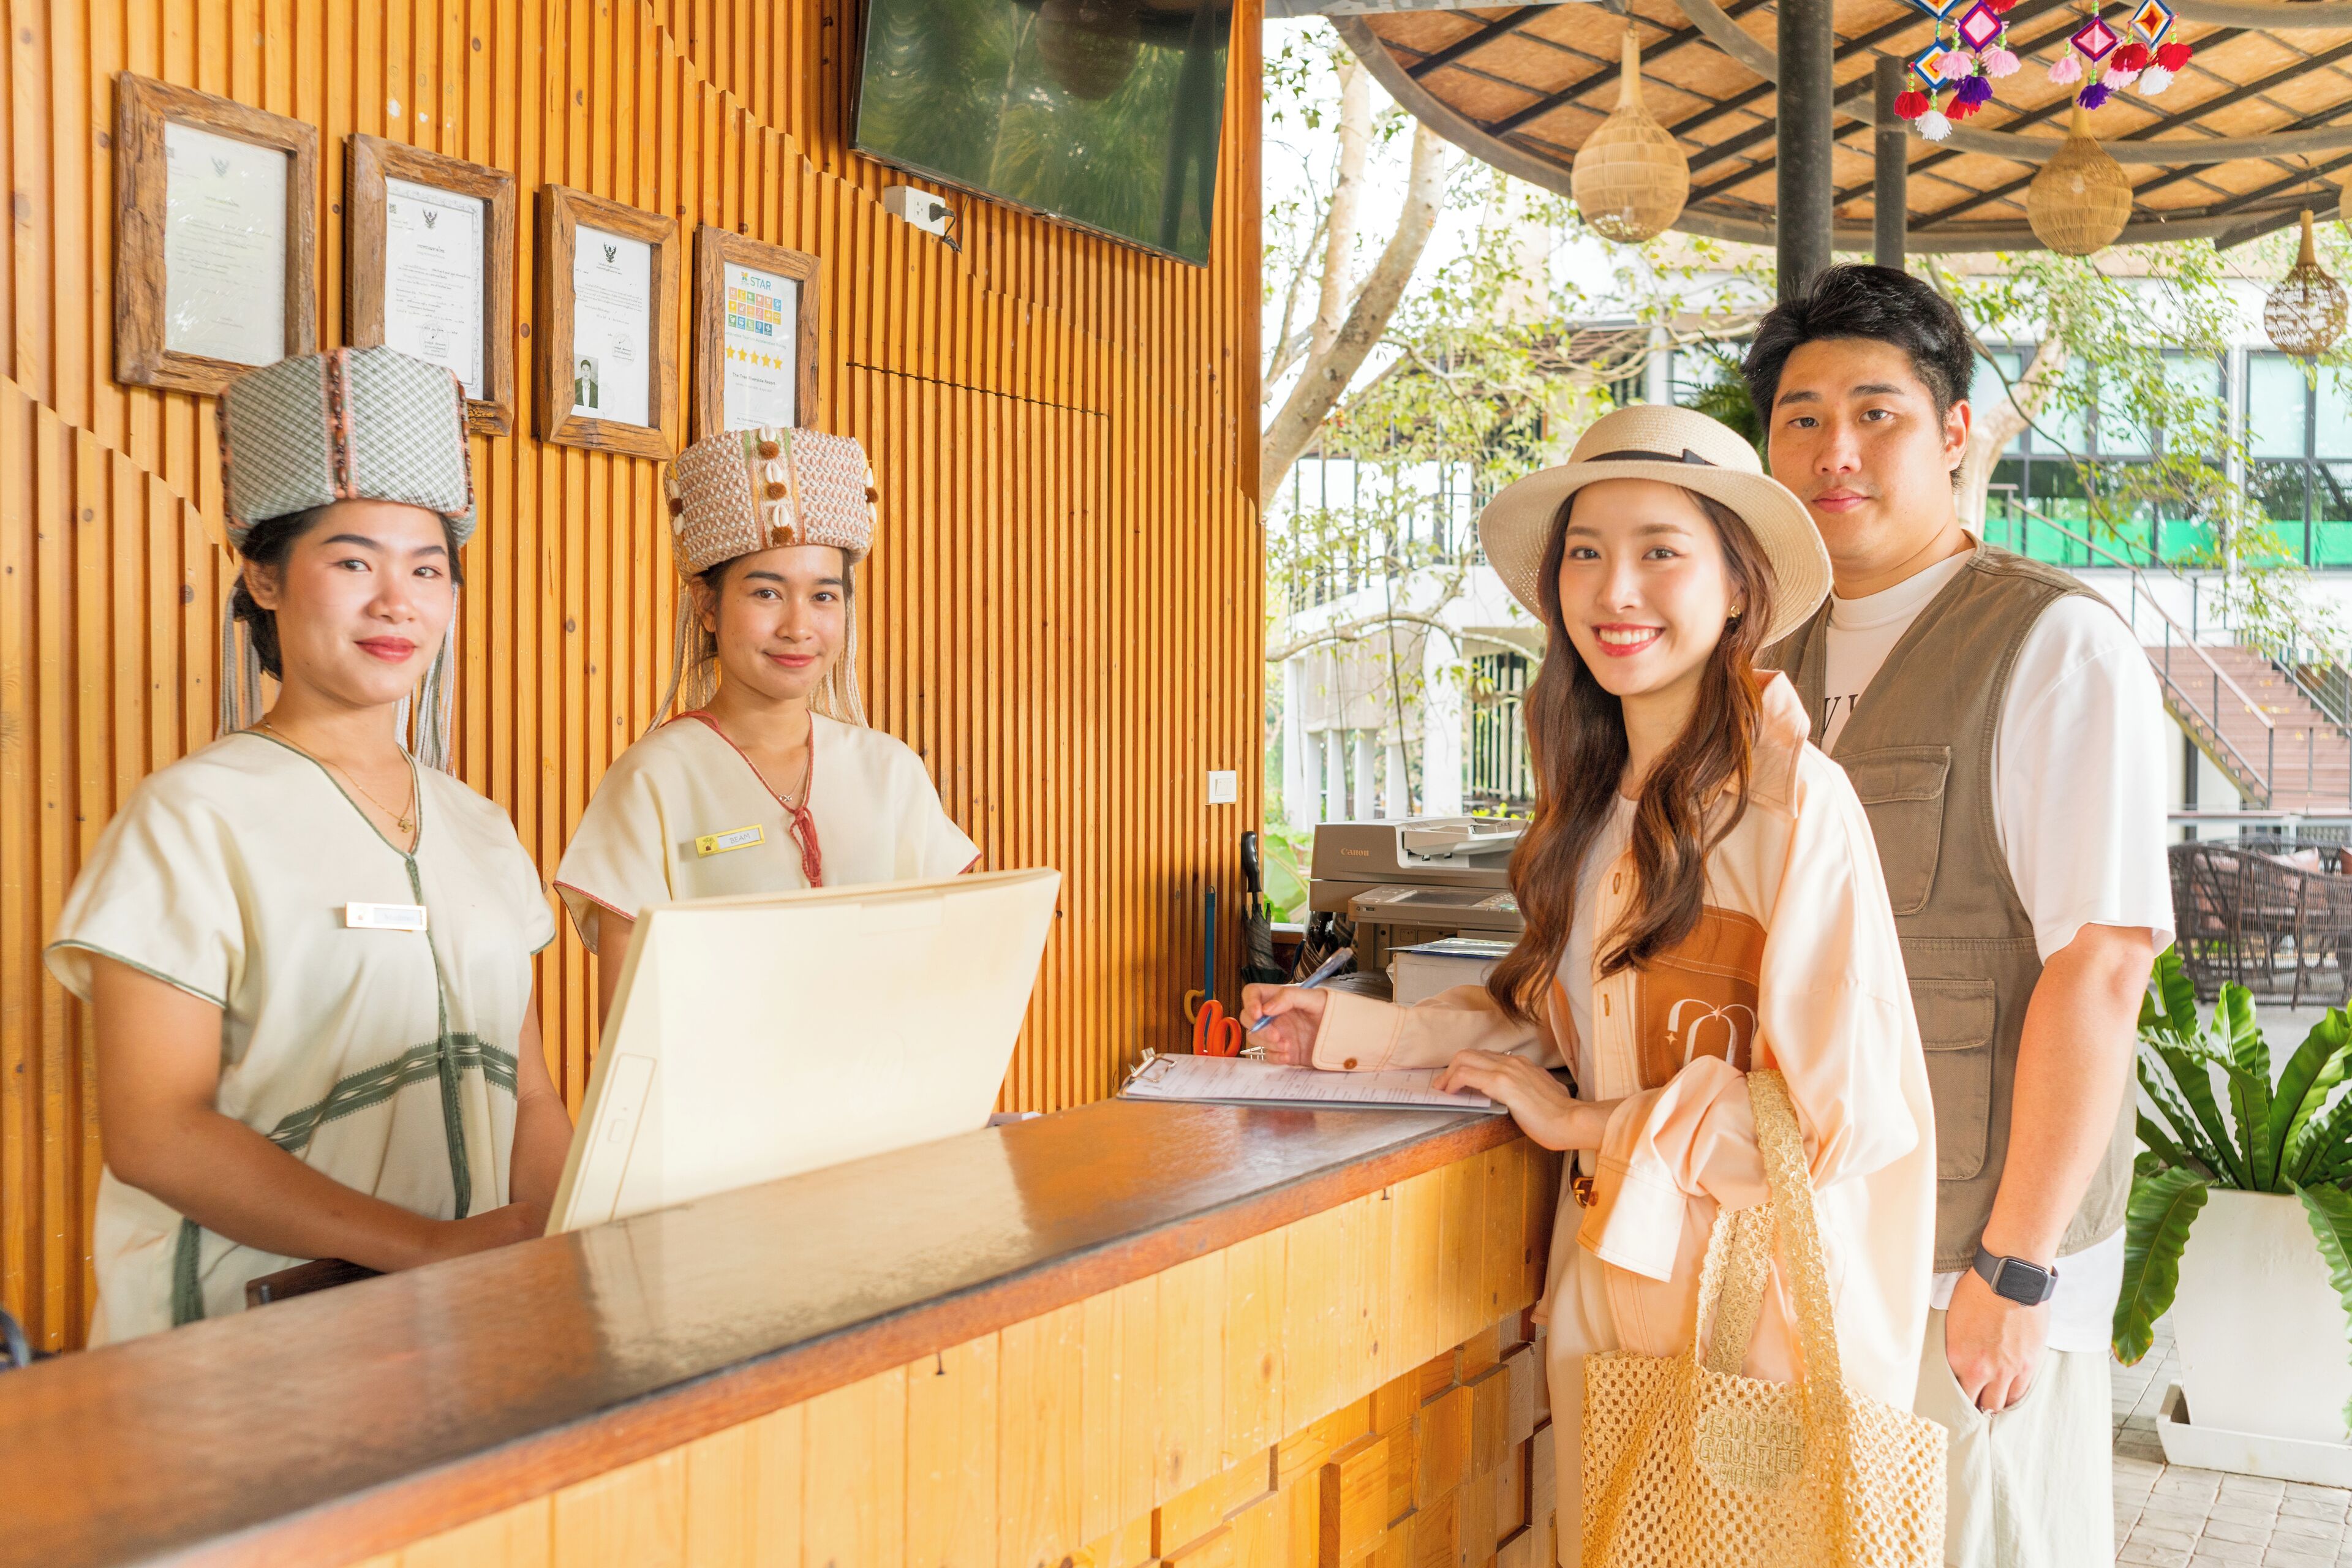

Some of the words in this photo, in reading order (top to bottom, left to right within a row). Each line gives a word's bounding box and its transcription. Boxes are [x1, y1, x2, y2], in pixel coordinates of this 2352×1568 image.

[750, 276, 772, 291] STAR
[729, 832, 750, 844] BEAM
[1340, 848, 1370, 857] Canon
[1698, 1413, 1750, 1442] JEAN
[1698, 1436, 1804, 1474] GAULTIER
